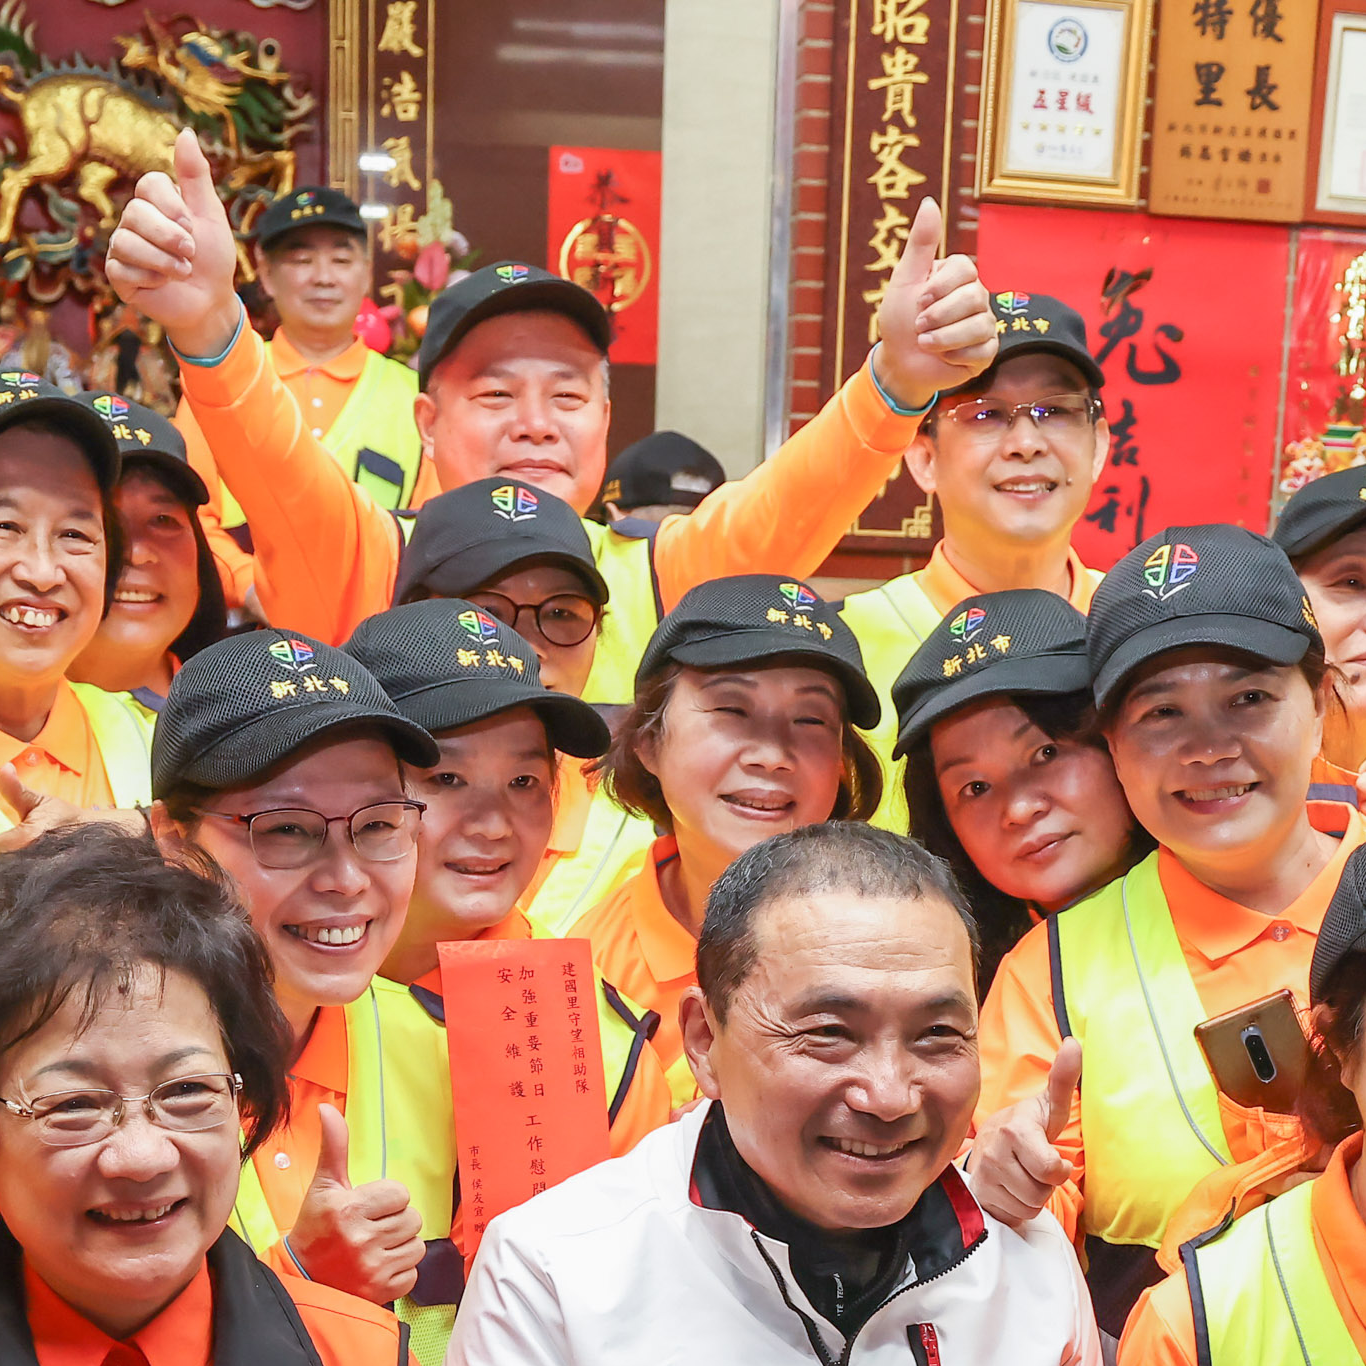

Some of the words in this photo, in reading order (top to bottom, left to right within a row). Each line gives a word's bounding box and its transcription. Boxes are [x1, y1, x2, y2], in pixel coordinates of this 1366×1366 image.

[766, 607, 833, 641] 新北市
[456, 648, 525, 675] 新北市
[942, 634, 1012, 677] 新北市
[269, 675, 351, 699] 新北市
[497, 967, 527, 1099] 安全維護
[561, 961, 590, 1094] 建國里守望相助隊
